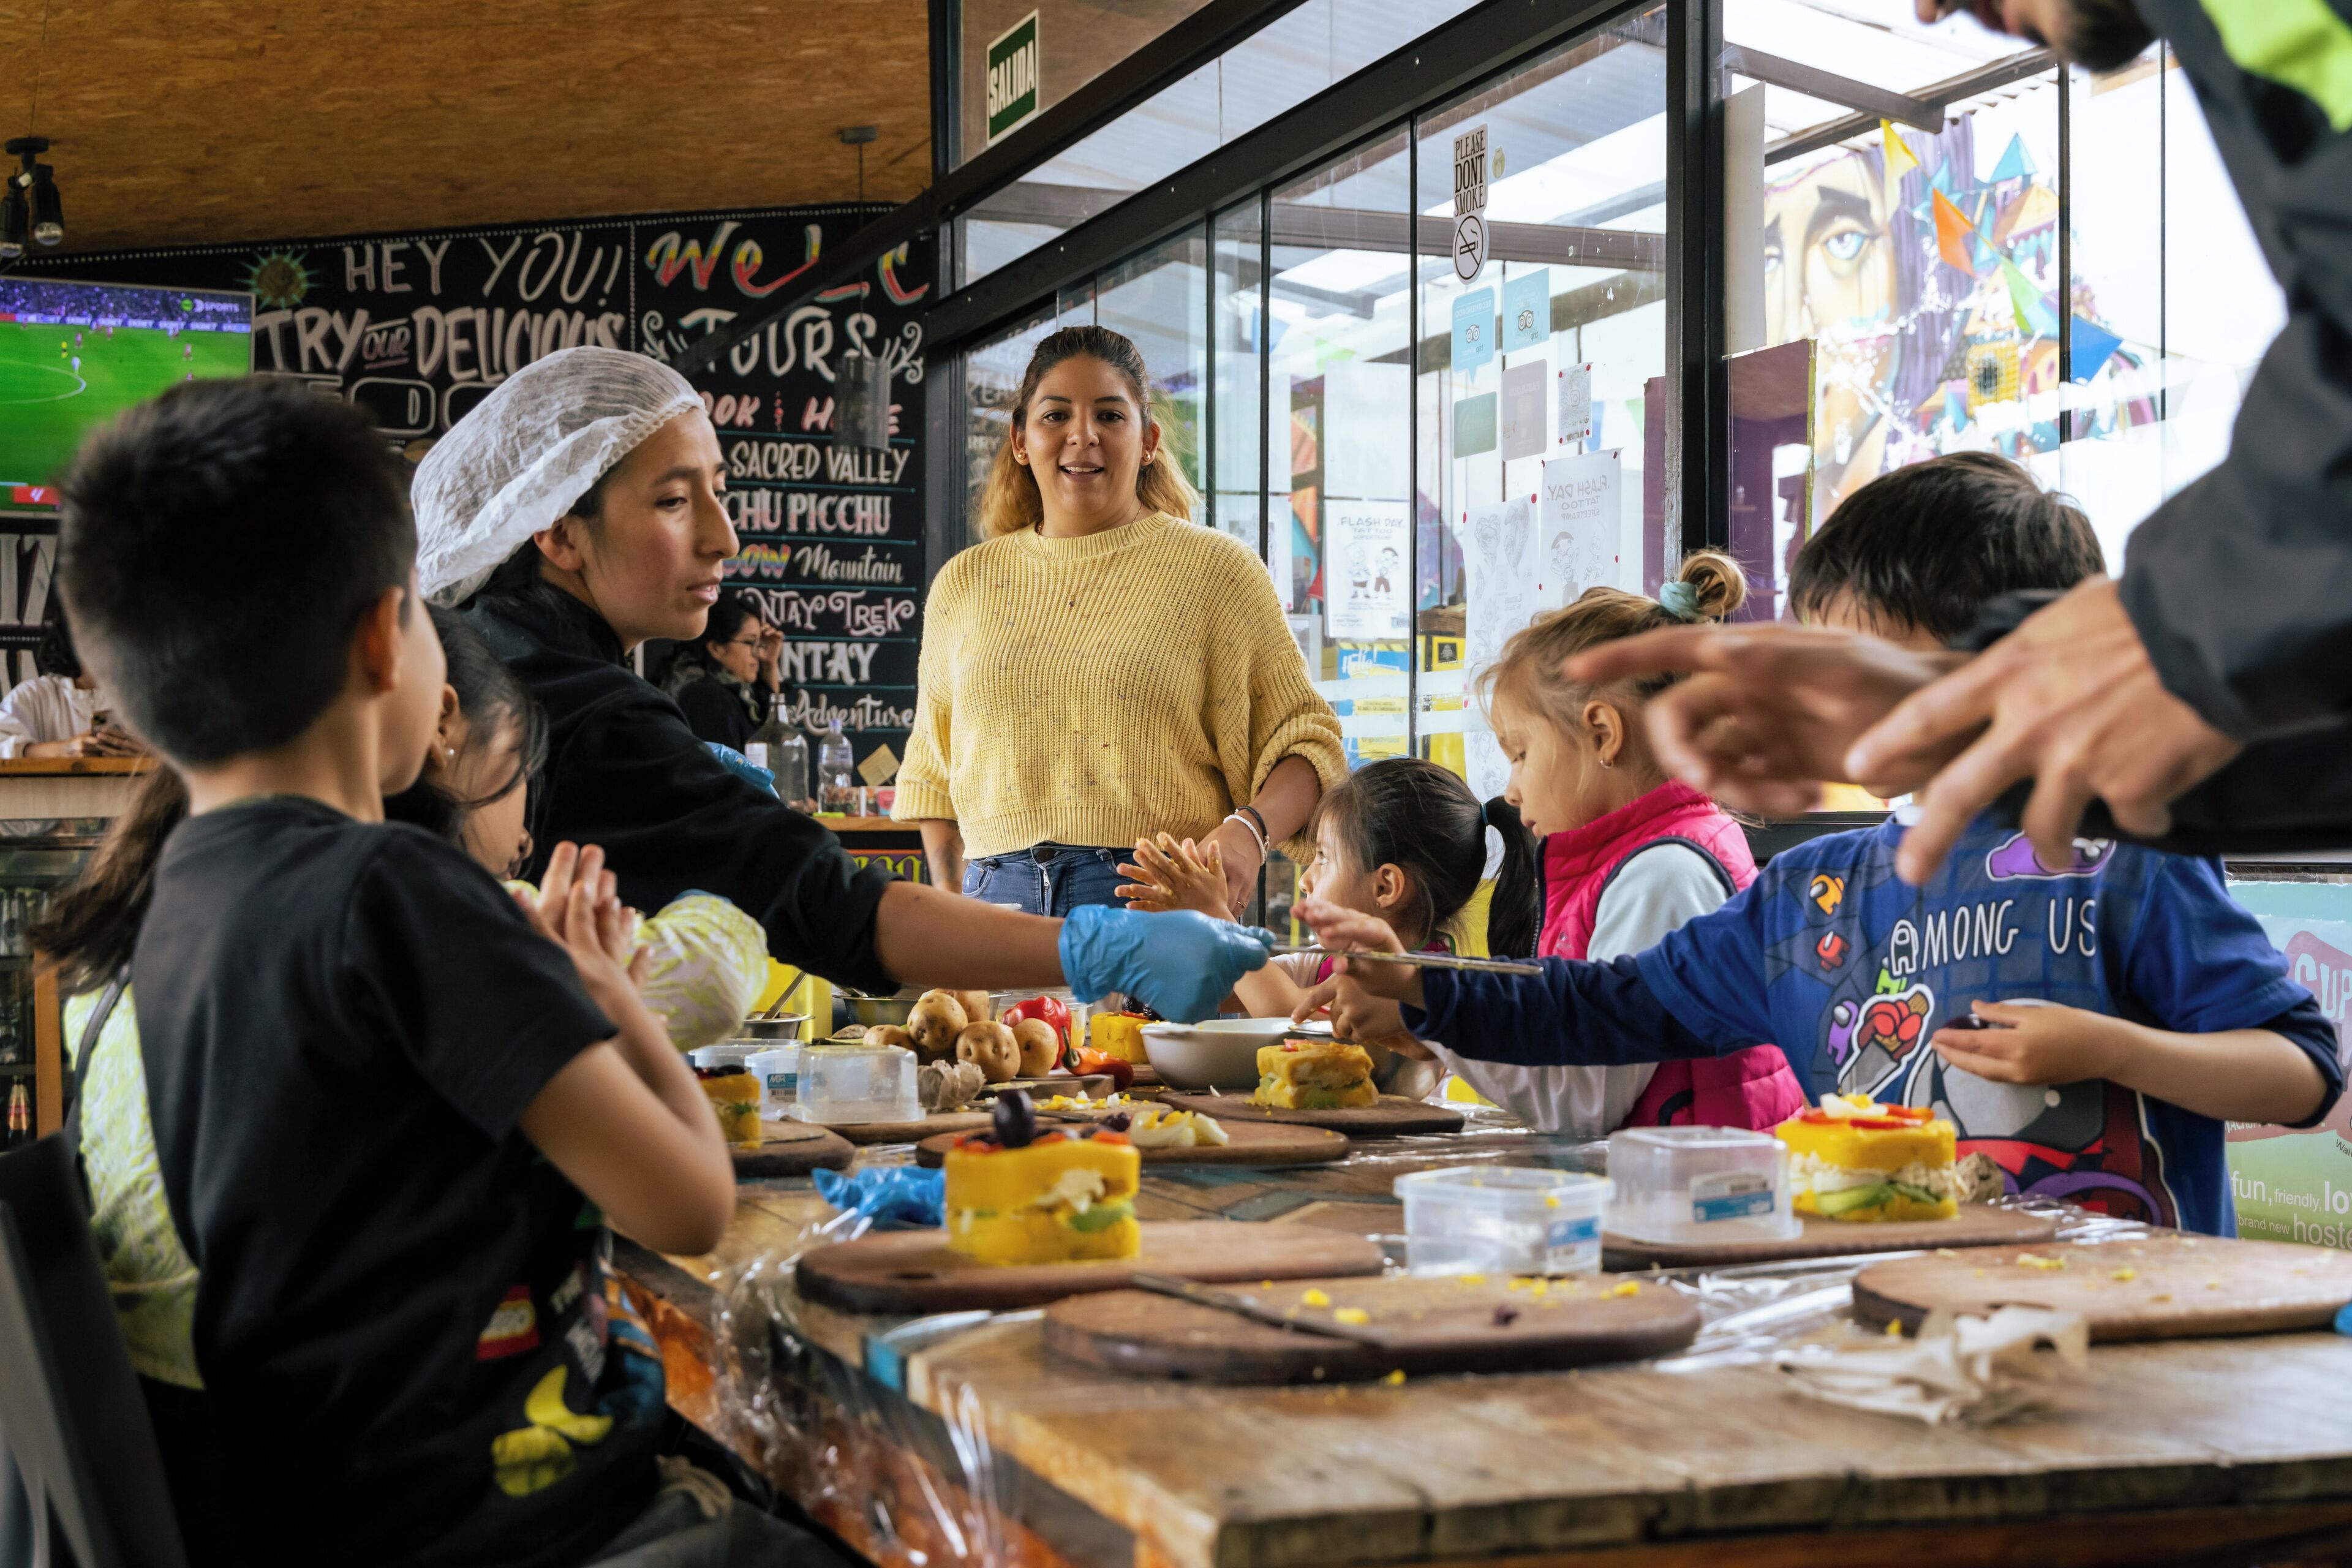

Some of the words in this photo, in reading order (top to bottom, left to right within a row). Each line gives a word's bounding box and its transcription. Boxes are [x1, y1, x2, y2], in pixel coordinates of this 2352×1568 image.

[989, 39, 1035, 118] SALIDA
[1455, 130, 1485, 162] PLEASE
[1455, 154, 1485, 194] DONT
[1455, 185, 1485, 217] SMOKE
[344, 241, 452, 295] HEY
[479, 231, 623, 306] YOU!
[254, 307, 369, 372] TRY
[678, 306, 877, 383] TOURS
[730, 441, 821, 480] SACRED
[825, 445, 910, 484] VALLEY
[786, 492, 892, 536] PICCHU
[1891, 899, 2019, 976] AMONG
[2048, 897, 2097, 957] US
[2336, 1139, 2352, 1158] Wal
[2231, 1170, 2272, 1207] fun,
[2274, 1188, 2321, 1213] friendly,
[2324, 1181, 2352, 1215] lo
[2237, 1213, 2266, 1230] brand
[2269, 1221, 2290, 1235] new
